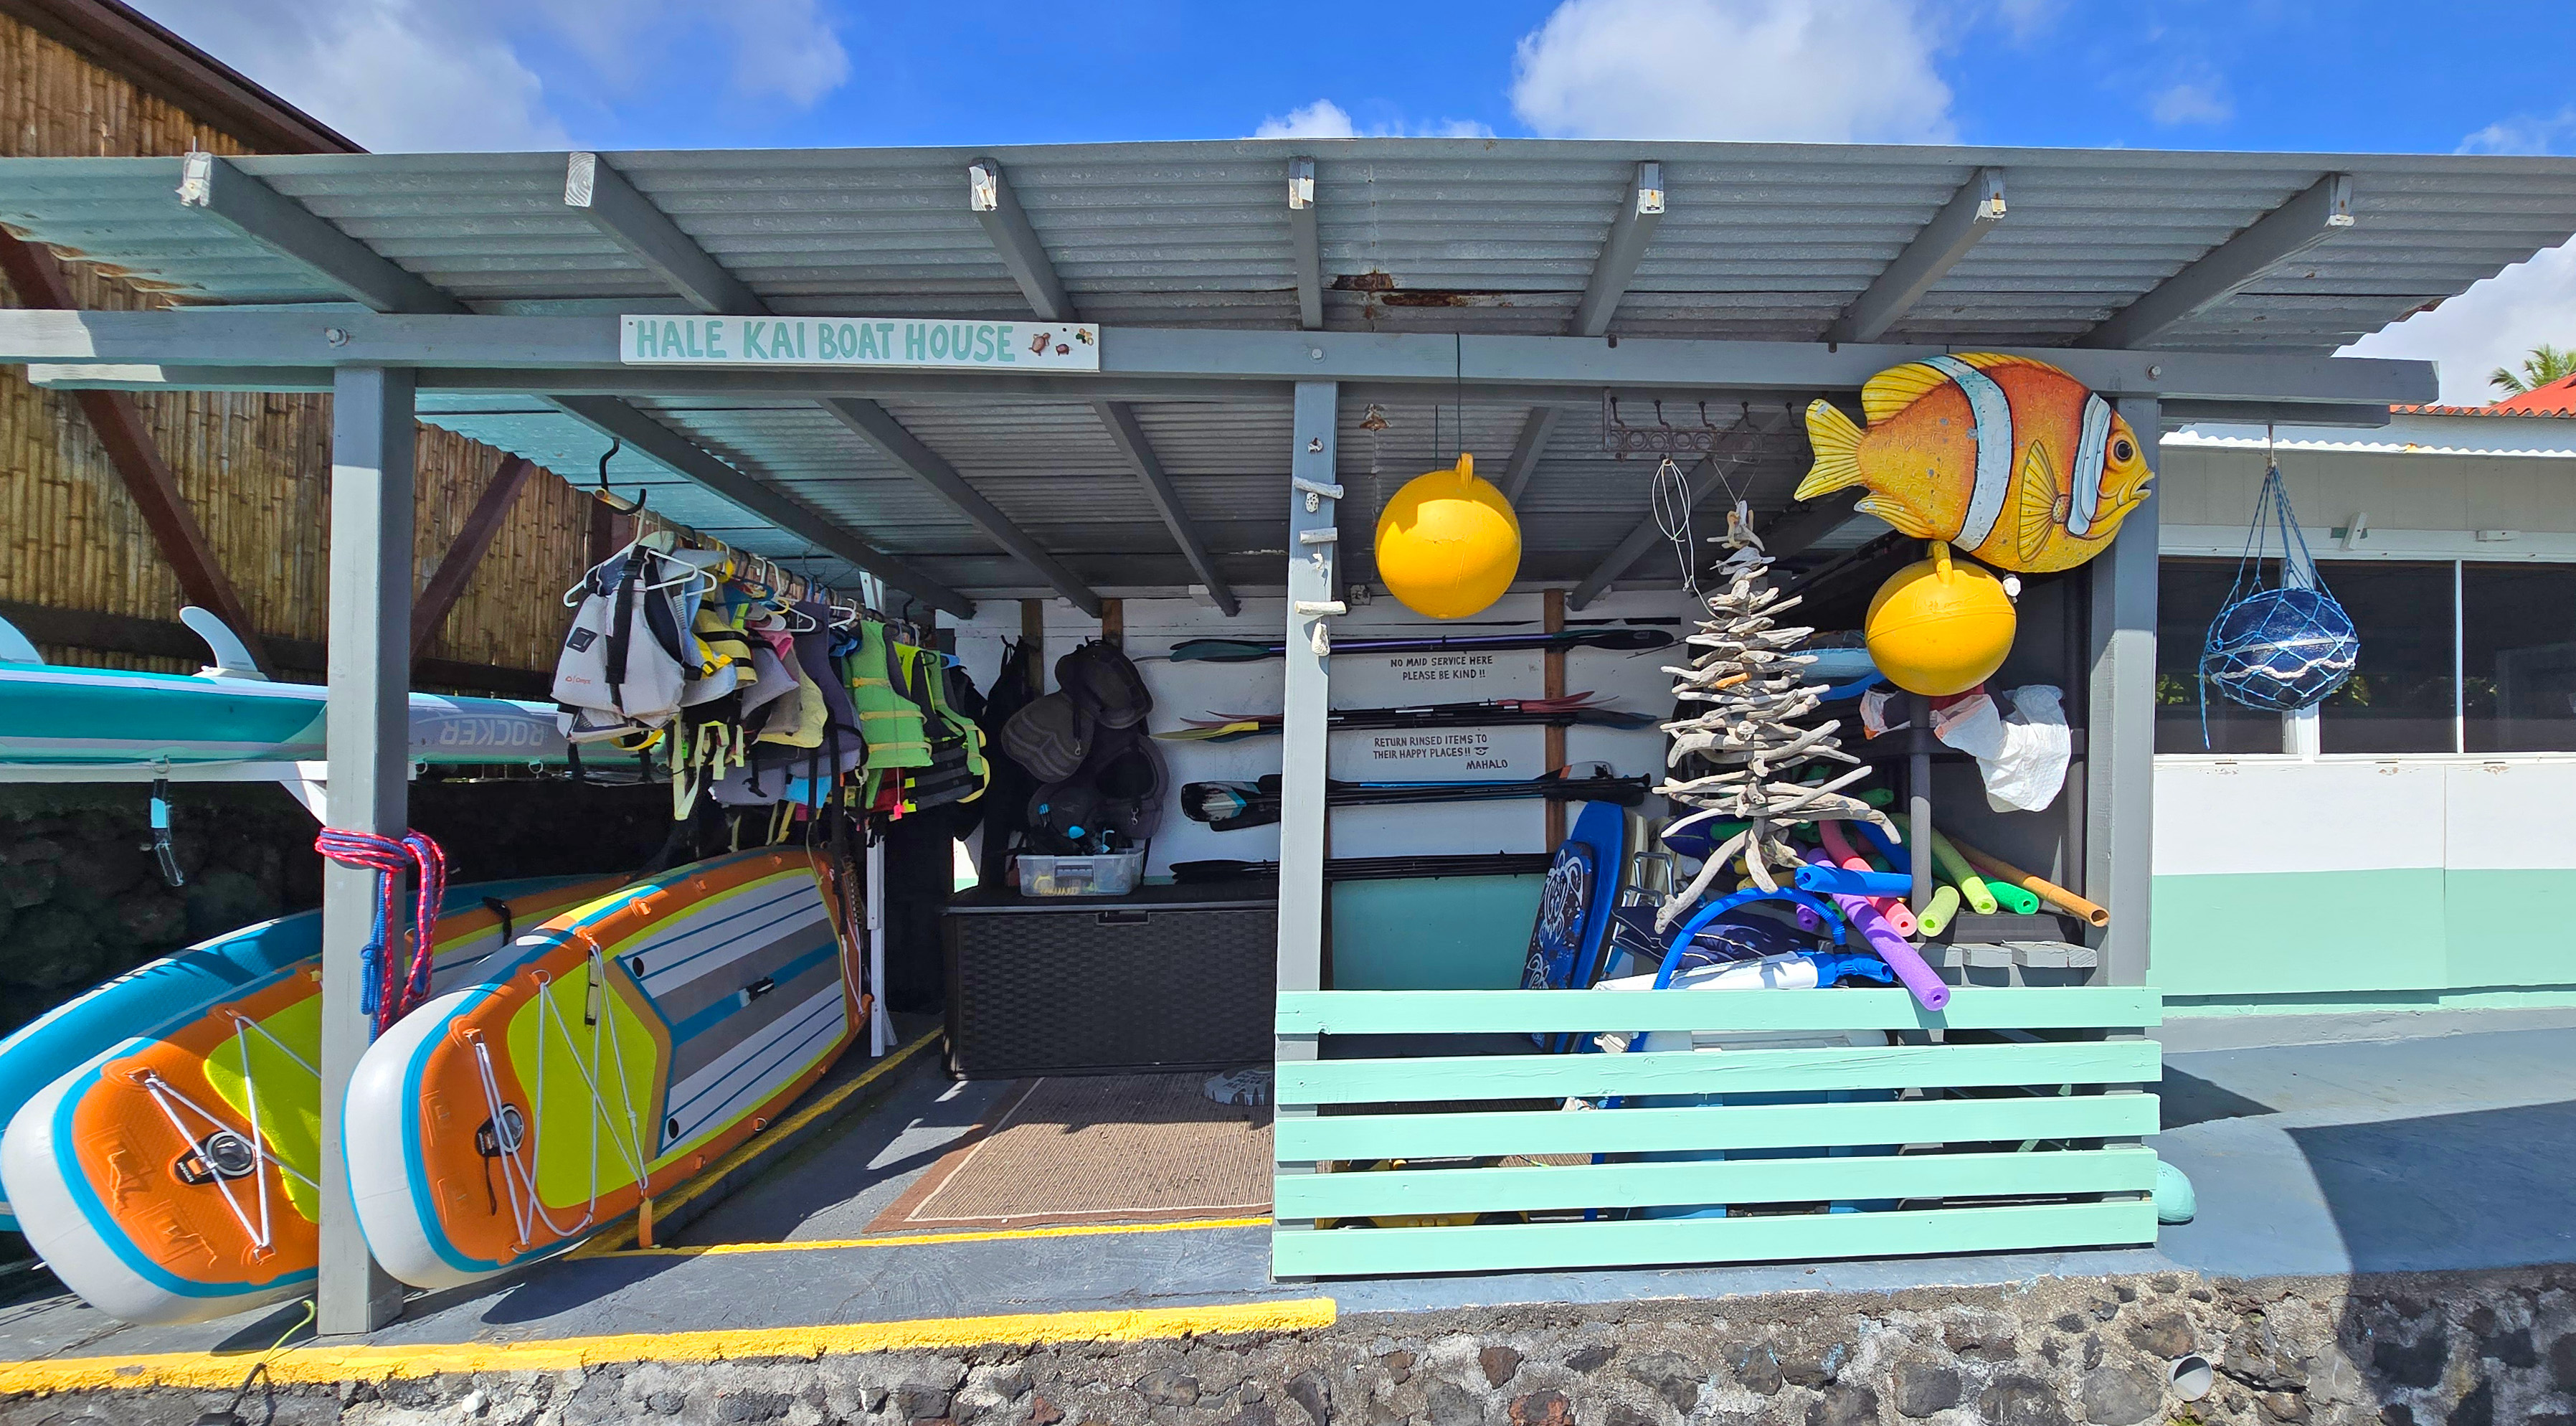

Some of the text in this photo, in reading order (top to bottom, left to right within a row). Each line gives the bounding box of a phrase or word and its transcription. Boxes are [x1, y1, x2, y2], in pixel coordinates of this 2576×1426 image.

[637, 320, 1015, 362] HALE KAI BOAT HOUSE
[1390, 655, 1493, 668] NO MAID SERVICE HERE
[1402, 671, 1436, 681] PLEASE
[1439, 670, 1450, 679] BE
[1452, 669, 1477, 679] KIND
[1374, 734, 1487, 747] RETURN RINSED ITEMS TO
[1373, 750, 1398, 760] THEIR
[1399, 748, 1427, 759] HAPPY
[1466, 759, 1508, 770] MAHALO
